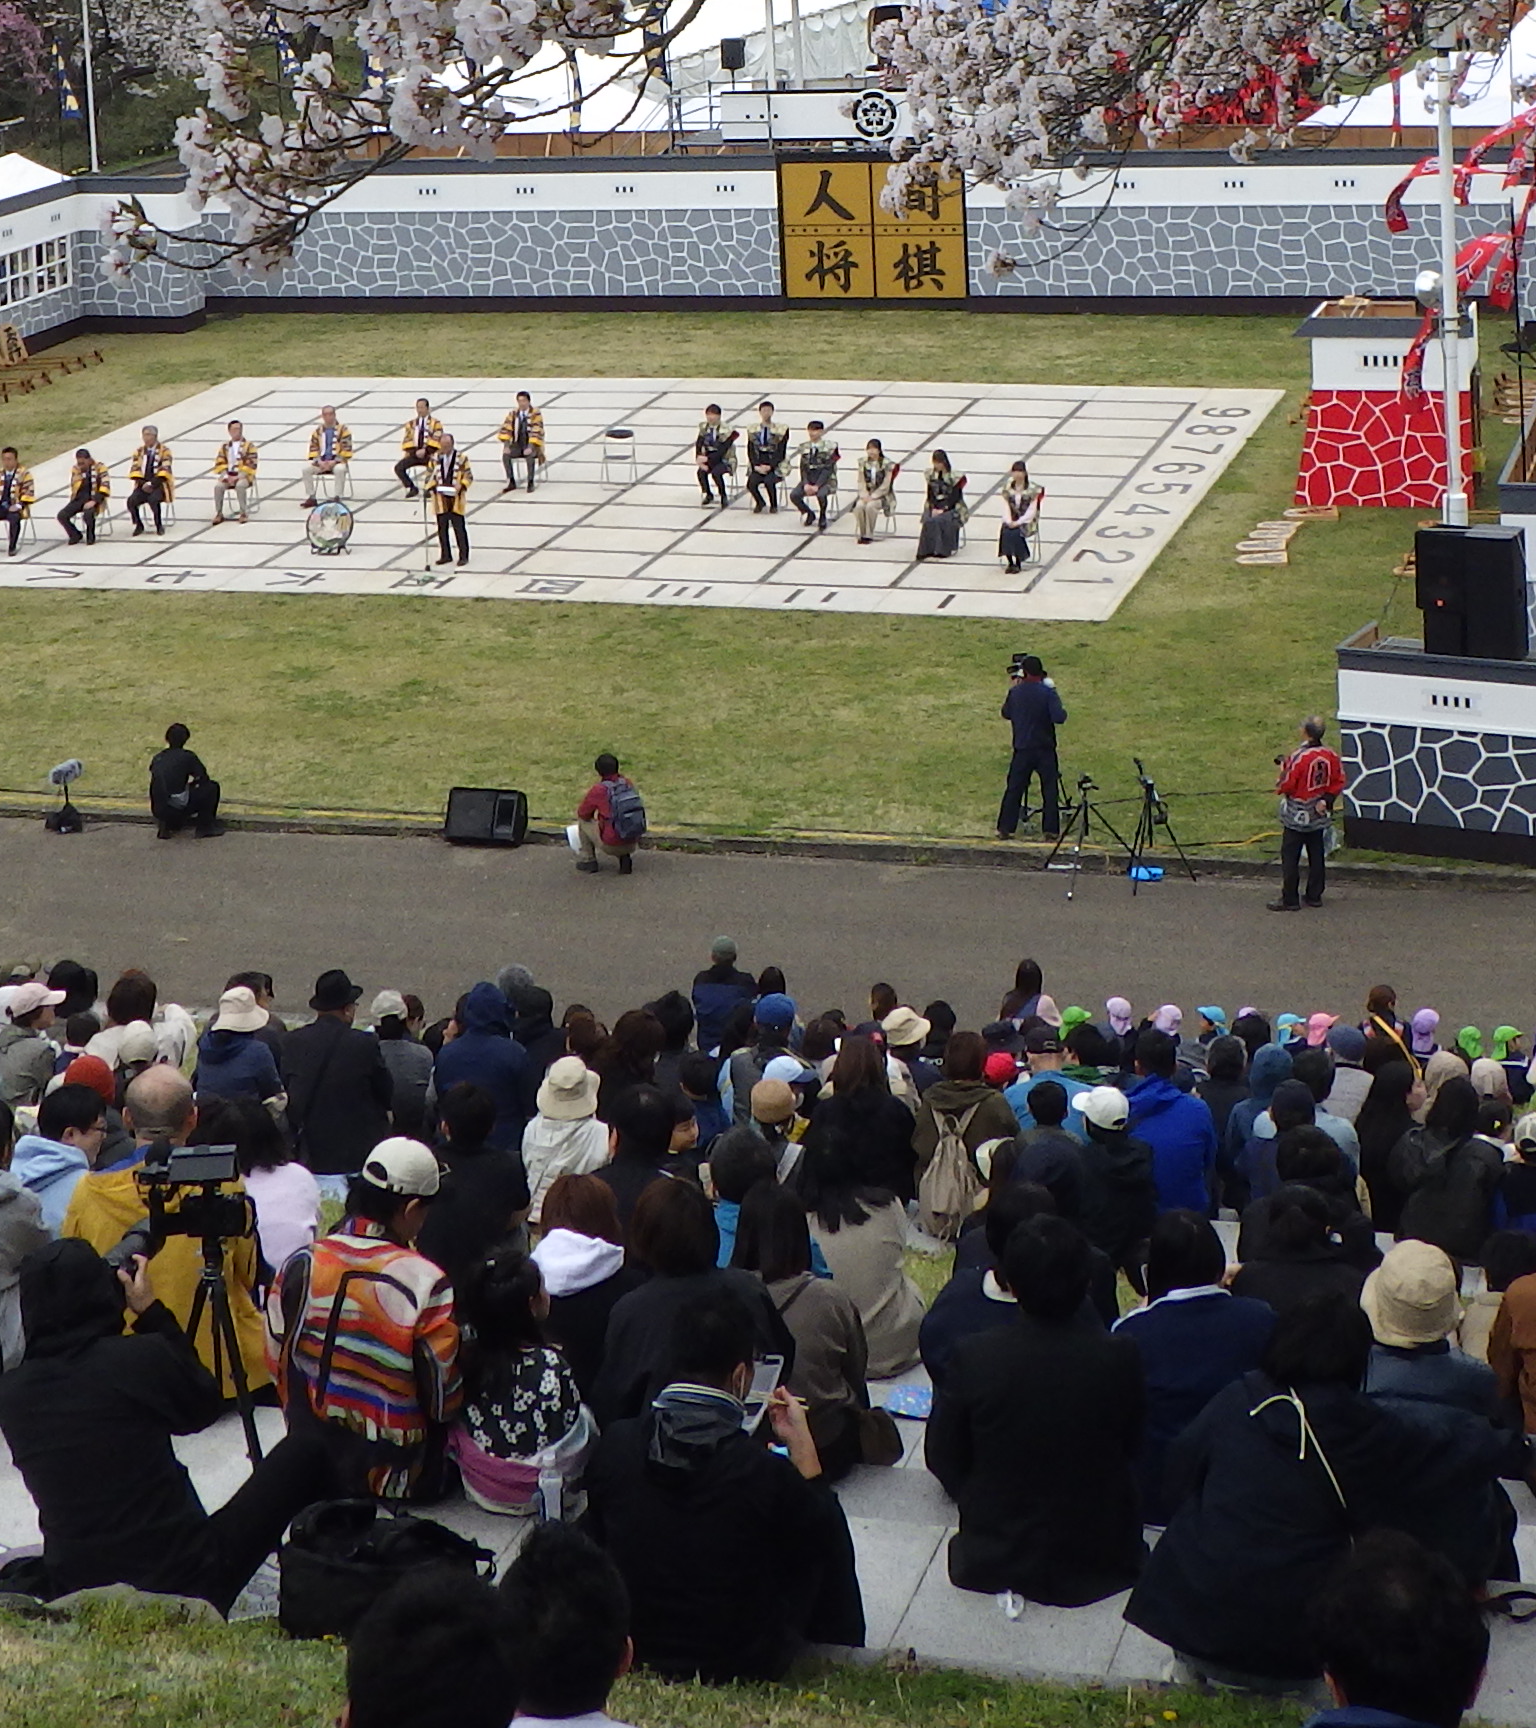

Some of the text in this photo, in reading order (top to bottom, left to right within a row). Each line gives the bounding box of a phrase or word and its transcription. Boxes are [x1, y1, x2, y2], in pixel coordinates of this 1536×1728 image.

[805, 240, 947, 294] 将棋
[1053, 407, 1251, 584] 9 8 7 6 5 4 3 2 1
